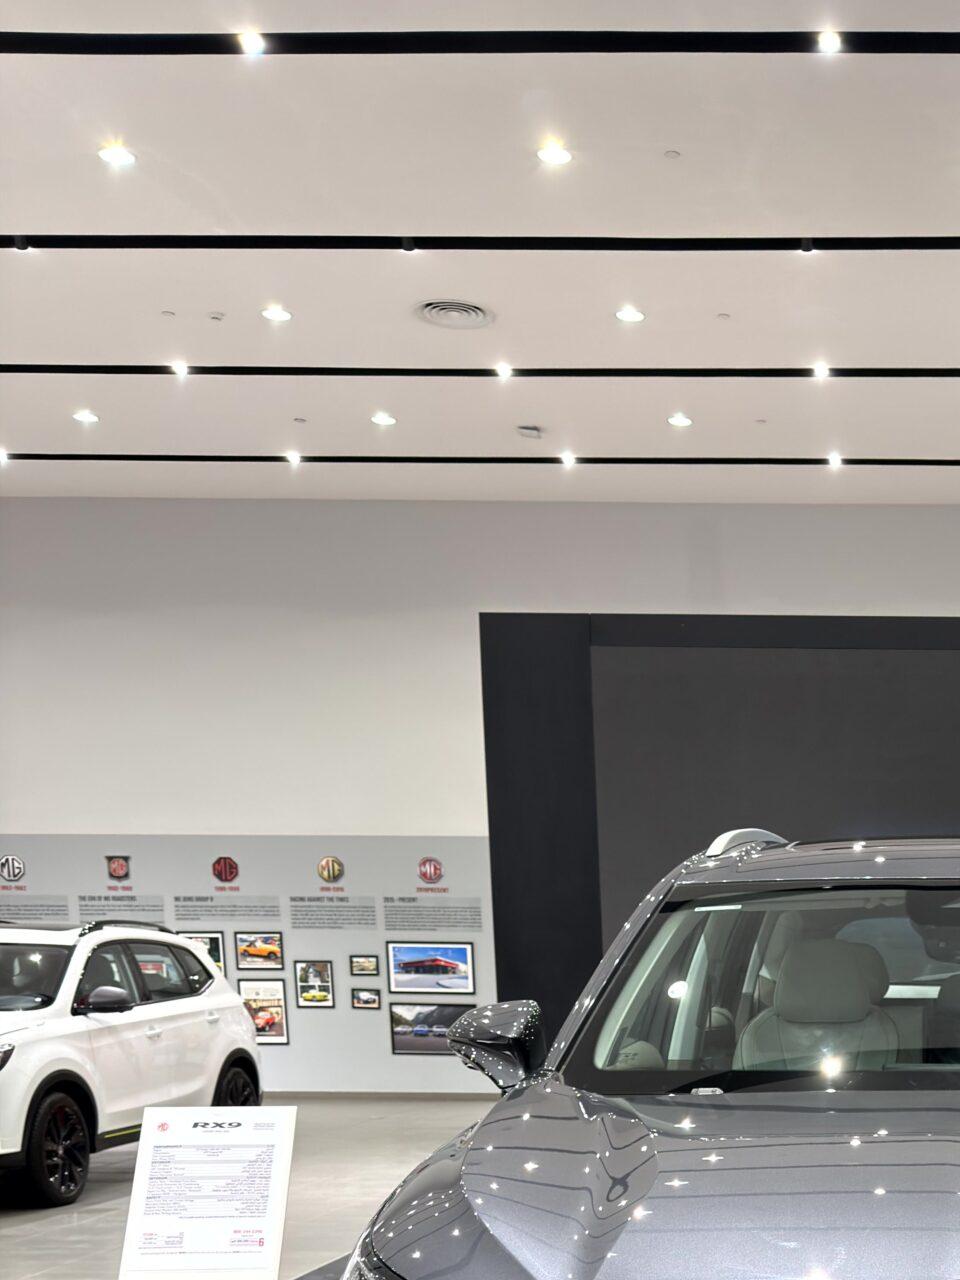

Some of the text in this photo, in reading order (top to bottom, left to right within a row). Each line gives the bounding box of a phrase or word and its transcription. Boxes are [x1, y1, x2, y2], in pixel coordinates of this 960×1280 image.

[0, 857, 22, 878] MG
[213, 860, 237, 881] MG
[318, 858, 343, 881] MG
[419, 859, 442, 881] MG
[192, 1121, 242, 1129] RX9
